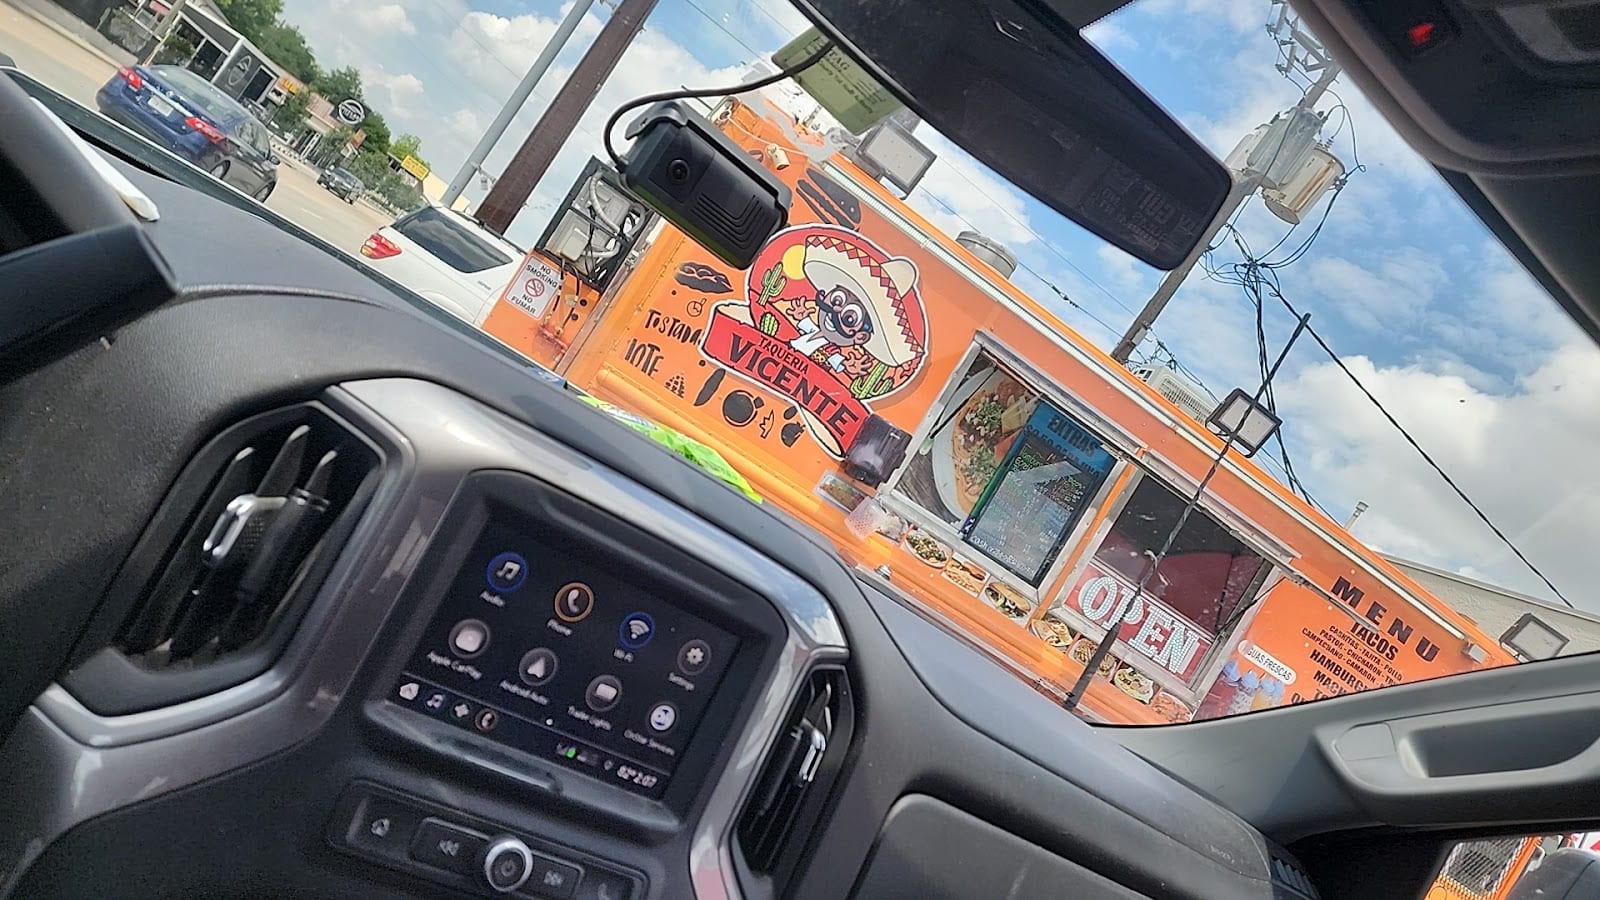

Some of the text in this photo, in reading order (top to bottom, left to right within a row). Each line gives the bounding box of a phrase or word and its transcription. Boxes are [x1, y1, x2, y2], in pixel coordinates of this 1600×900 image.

[526, 264, 558, 288] SMOKING
[540, 264, 552, 275] NO
[511, 296, 536, 314] FUMAR
[522, 294, 533, 303] NO
[758, 335, 809, 375] TAQUERIA
[730, 333, 859, 437] VICENTE
[1046, 413, 1100, 458] EXTRAS
[1079, 576, 1200, 674] OPEN
[1331, 576, 1440, 662] MENU
[1302, 627, 1376, 683] CAMPECHANO CAMARON
[1320, 629, 1342, 649] PASTOR
[1346, 650, 1381, 676] CHICHARON
[1329, 625, 1359, 650] CARNITAS
[1384, 664, 1403, 681] POLLO
[1350, 621, 1399, 661] TACOS
[1262, 657, 1293, 681] FRESCAS
[1309, 649, 1369, 691] HAMBURG
